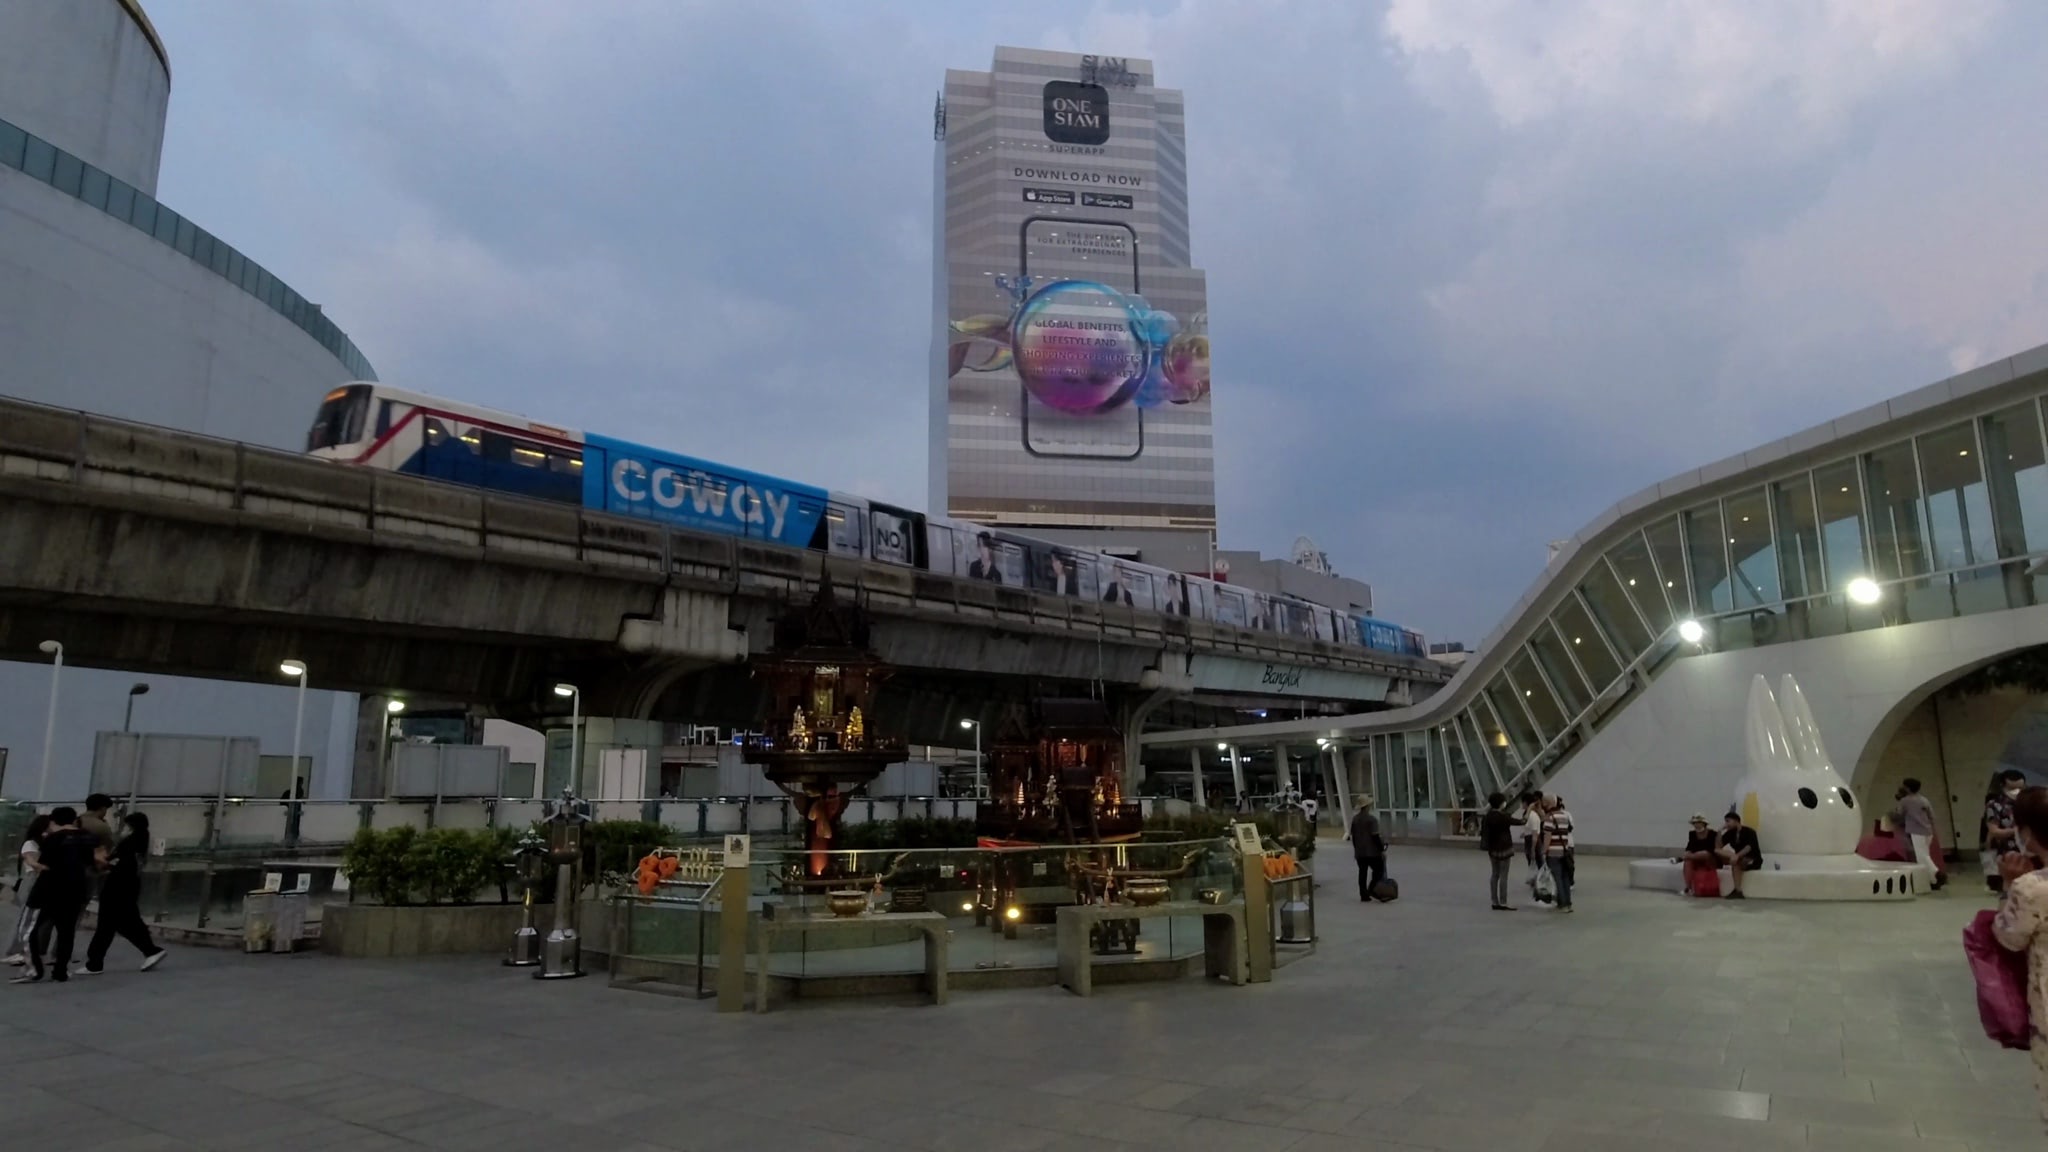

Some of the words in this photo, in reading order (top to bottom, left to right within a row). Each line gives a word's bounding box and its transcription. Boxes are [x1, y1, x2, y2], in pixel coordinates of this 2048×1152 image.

[1053, 97, 1091, 113] ONE
[1054, 111, 1100, 128] SIAM
[1049, 144, 1105, 155] SUPERAPP
[1014, 167, 1101, 183] DOWNLOAD
[1107, 174, 1142, 186] NOW
[1039, 194, 1053, 203] App
[1053, 195, 1072, 204] Store
[1096, 198, 1117, 208] Google
[1118, 200, 1131, 209] Play
[1035, 319, 1075, 330] GLOBAL
[1077, 321, 1128, 333] BENEFITS,
[1043, 335, 1091, 347] LIFESTYLE
[1094, 338, 1117, 348] AND
[1262, 663, 1302, 692] Bangkok
